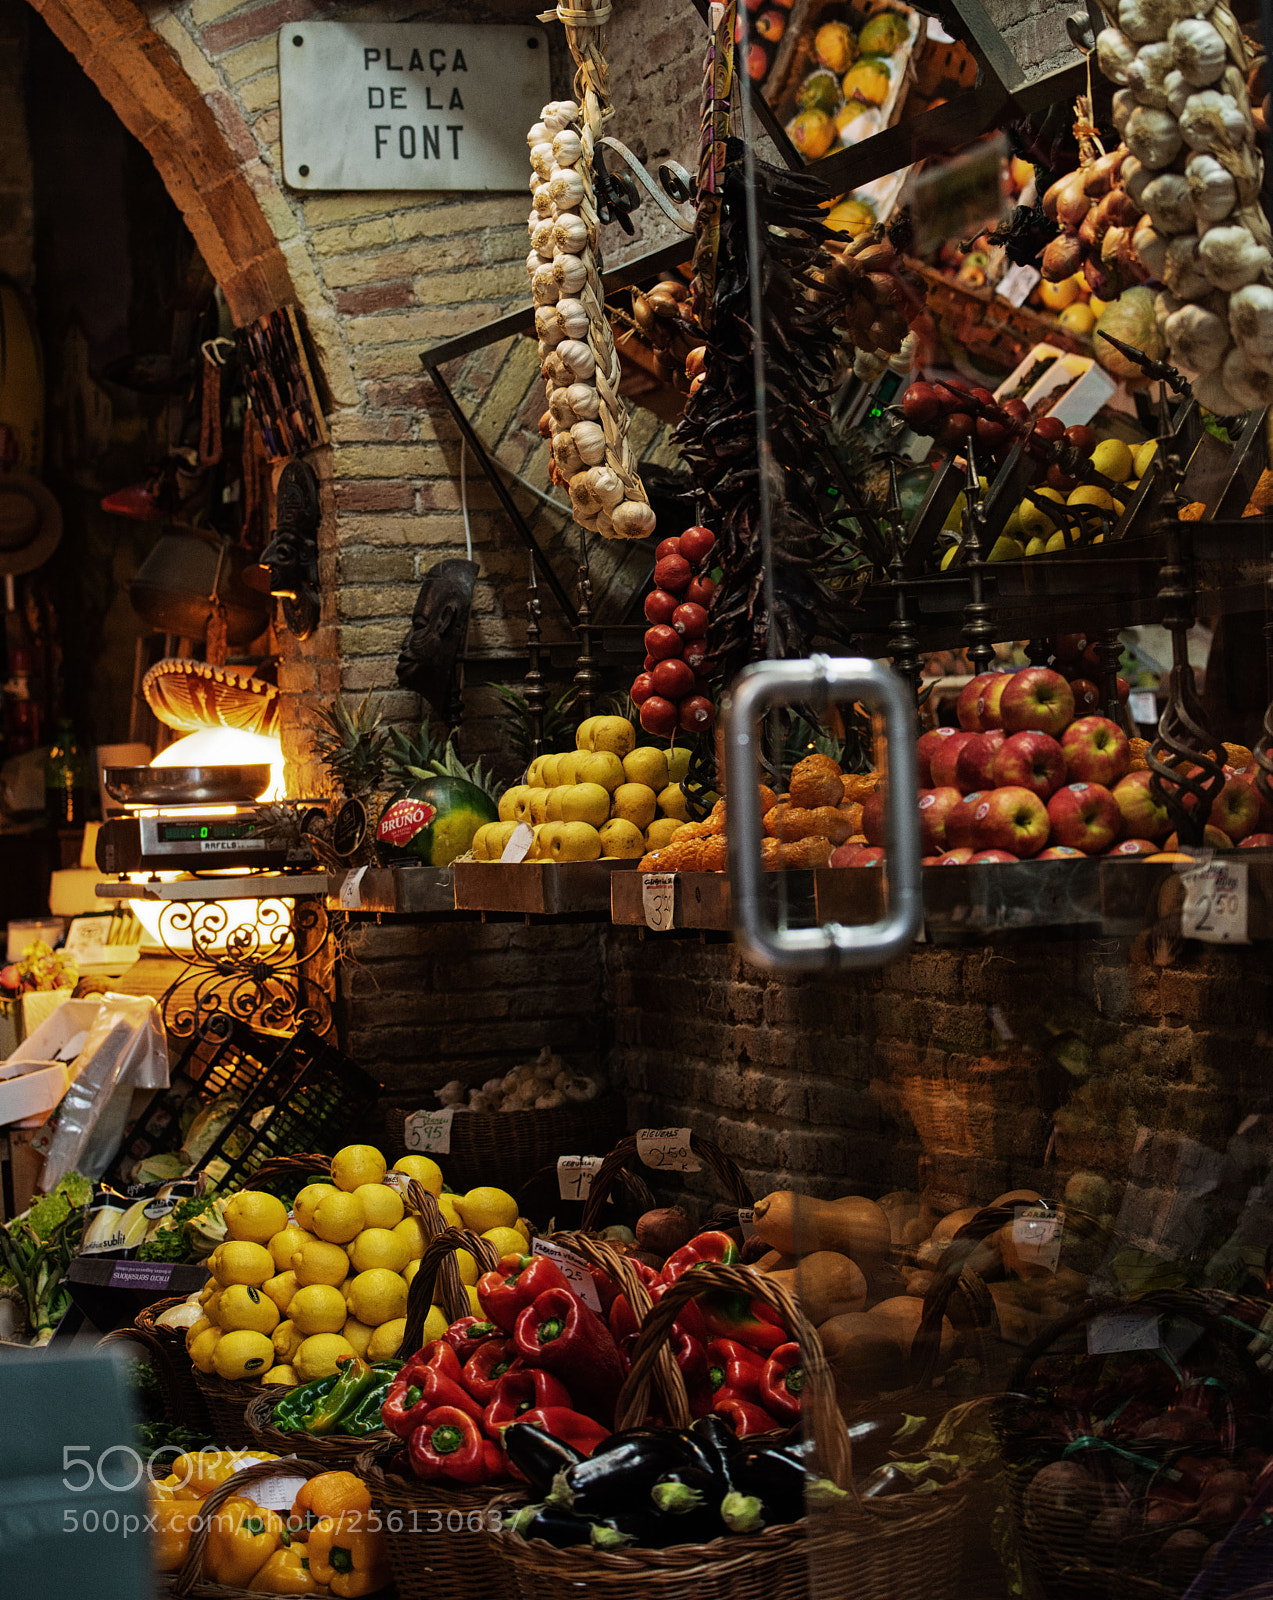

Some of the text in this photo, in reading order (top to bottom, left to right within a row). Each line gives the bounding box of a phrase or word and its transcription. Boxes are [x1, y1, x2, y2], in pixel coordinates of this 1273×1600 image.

[364, 48, 468, 77] PLAÇA
[368, 87, 465, 110] DE LA
[375, 125, 464, 160] FONT
